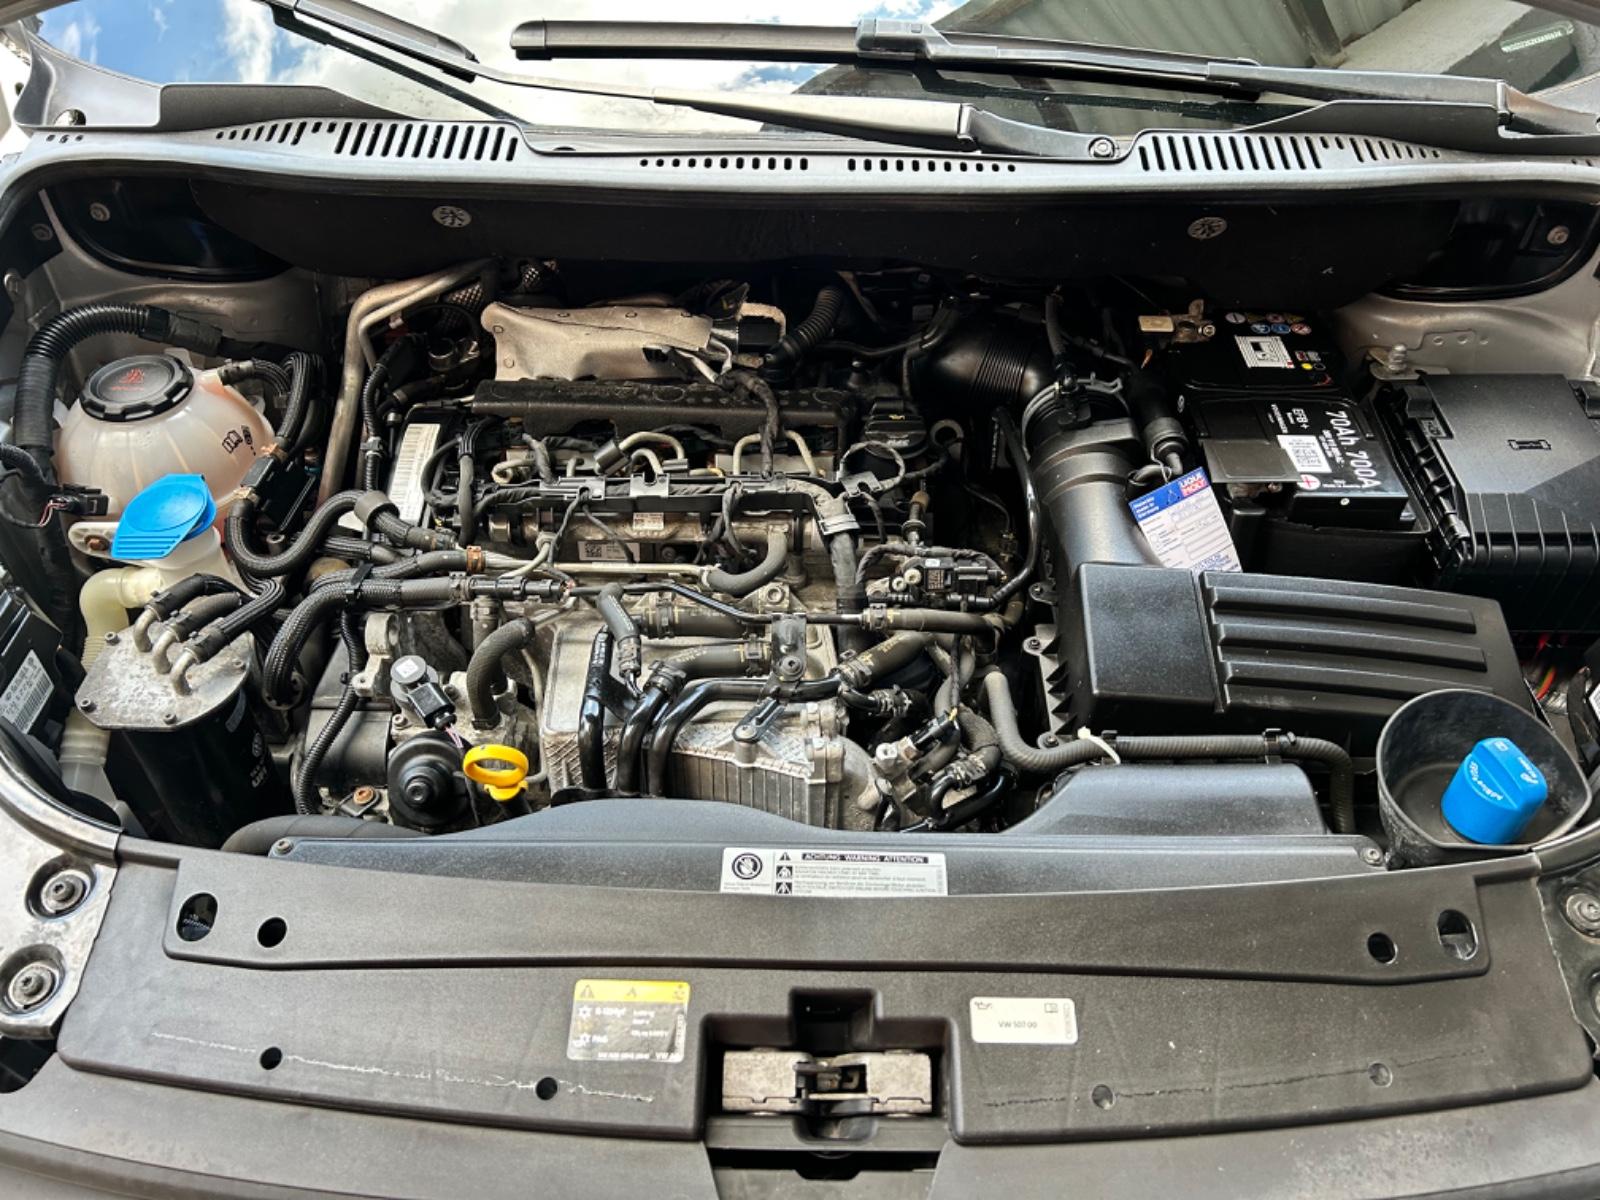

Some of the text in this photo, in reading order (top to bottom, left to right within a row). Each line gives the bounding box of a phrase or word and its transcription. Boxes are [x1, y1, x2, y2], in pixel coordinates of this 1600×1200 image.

[1325, 410, 1361, 446] 70Ah
[1345, 450, 1382, 489] 700A
[845, 854, 879, 862] WARNING
[883, 855, 924, 863] ATTENTION
[997, 1020, 1012, 1029] VW
